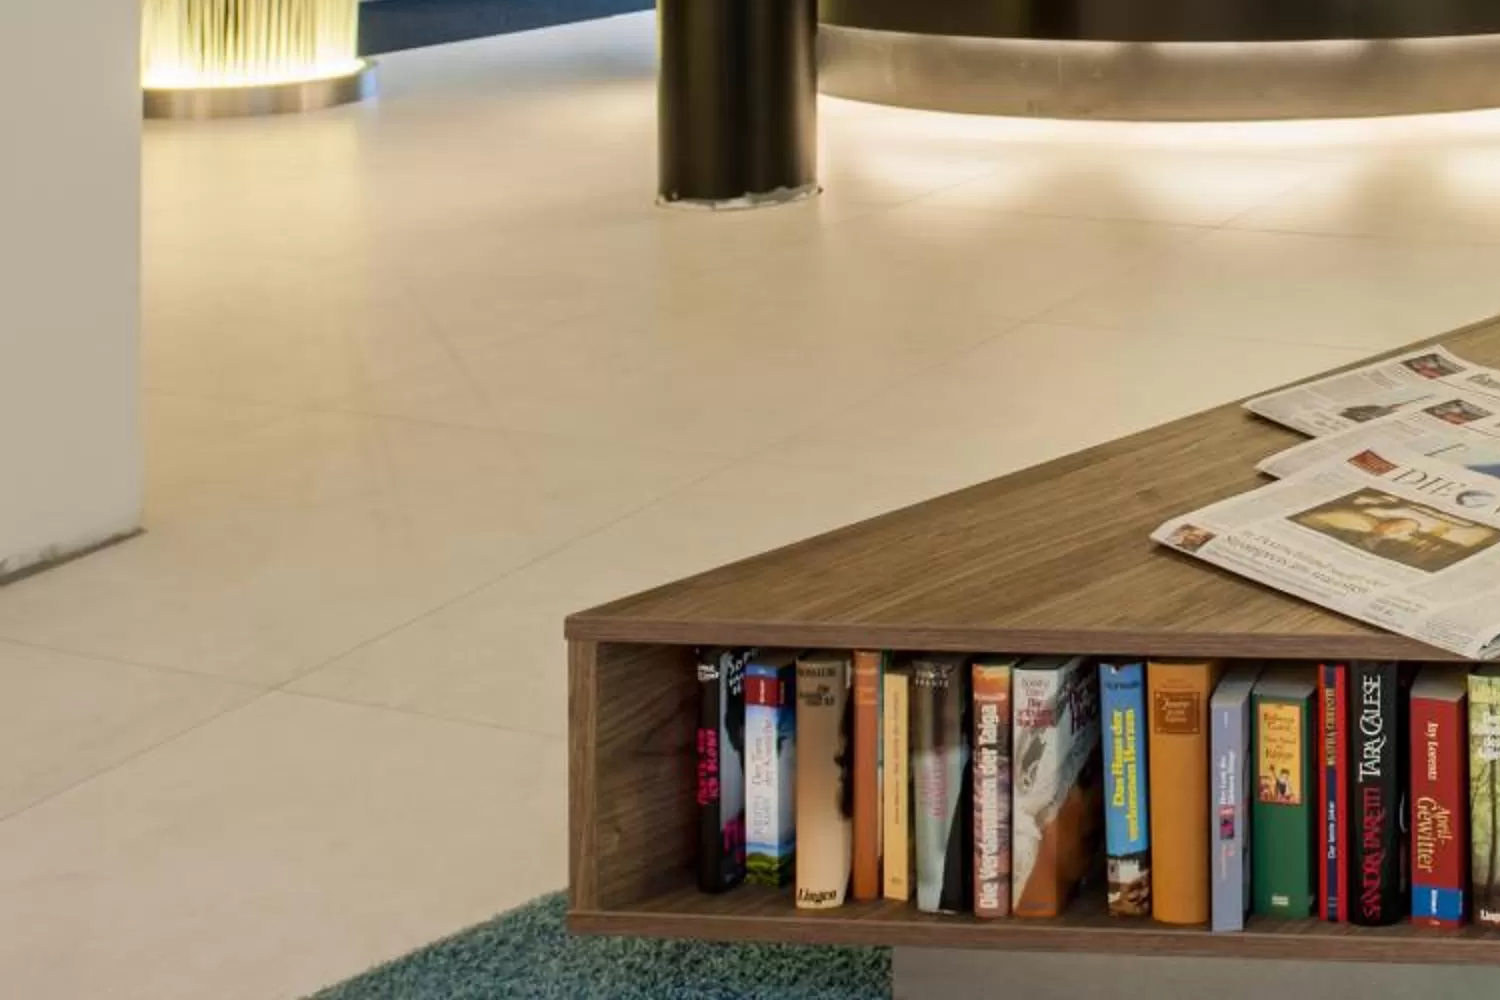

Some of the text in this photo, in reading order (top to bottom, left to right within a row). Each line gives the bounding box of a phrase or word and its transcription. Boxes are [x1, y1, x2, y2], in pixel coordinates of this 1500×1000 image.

[1392, 466, 1466, 496] DIE
[1358, 674, 1385, 783] TARA CALESE
[978, 704, 1000, 908] Die Verdammten der Taiga
[1417, 797, 1438, 873] Gewitter
[1360, 853, 1385, 919] SANDRA
